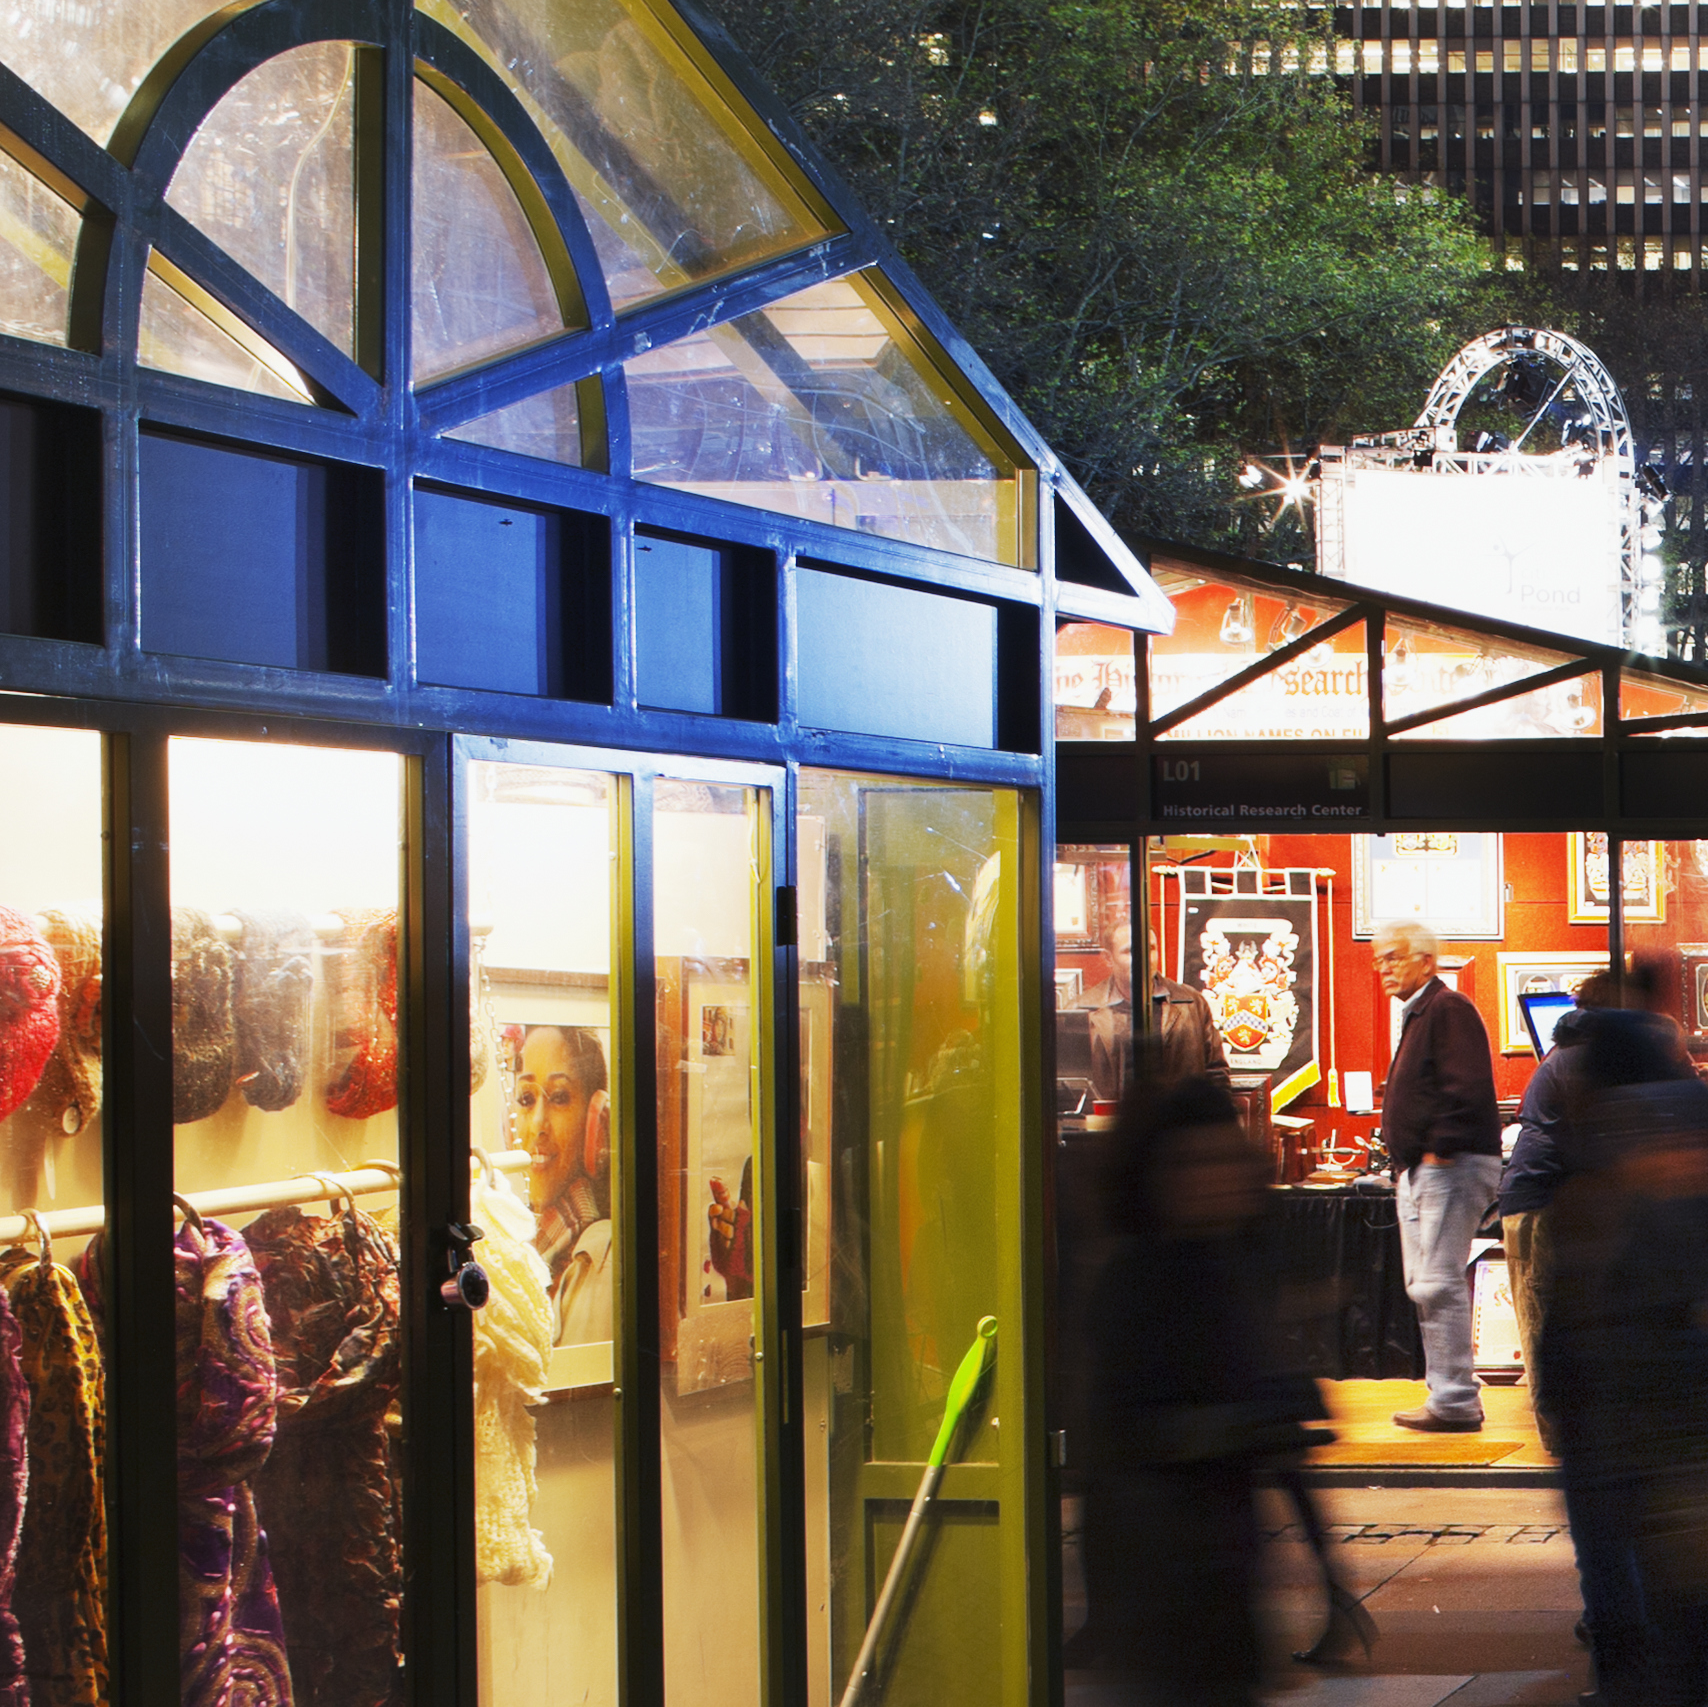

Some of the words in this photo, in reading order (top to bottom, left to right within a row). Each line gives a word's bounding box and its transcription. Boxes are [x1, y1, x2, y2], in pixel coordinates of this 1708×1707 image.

[1520, 584, 1581, 604] Pond
[1163, 760, 1200, 781] L01
[1163, 804, 1235, 817] Historical
[1239, 804, 1307, 817] Research
[1311, 804, 1363, 817] Center
